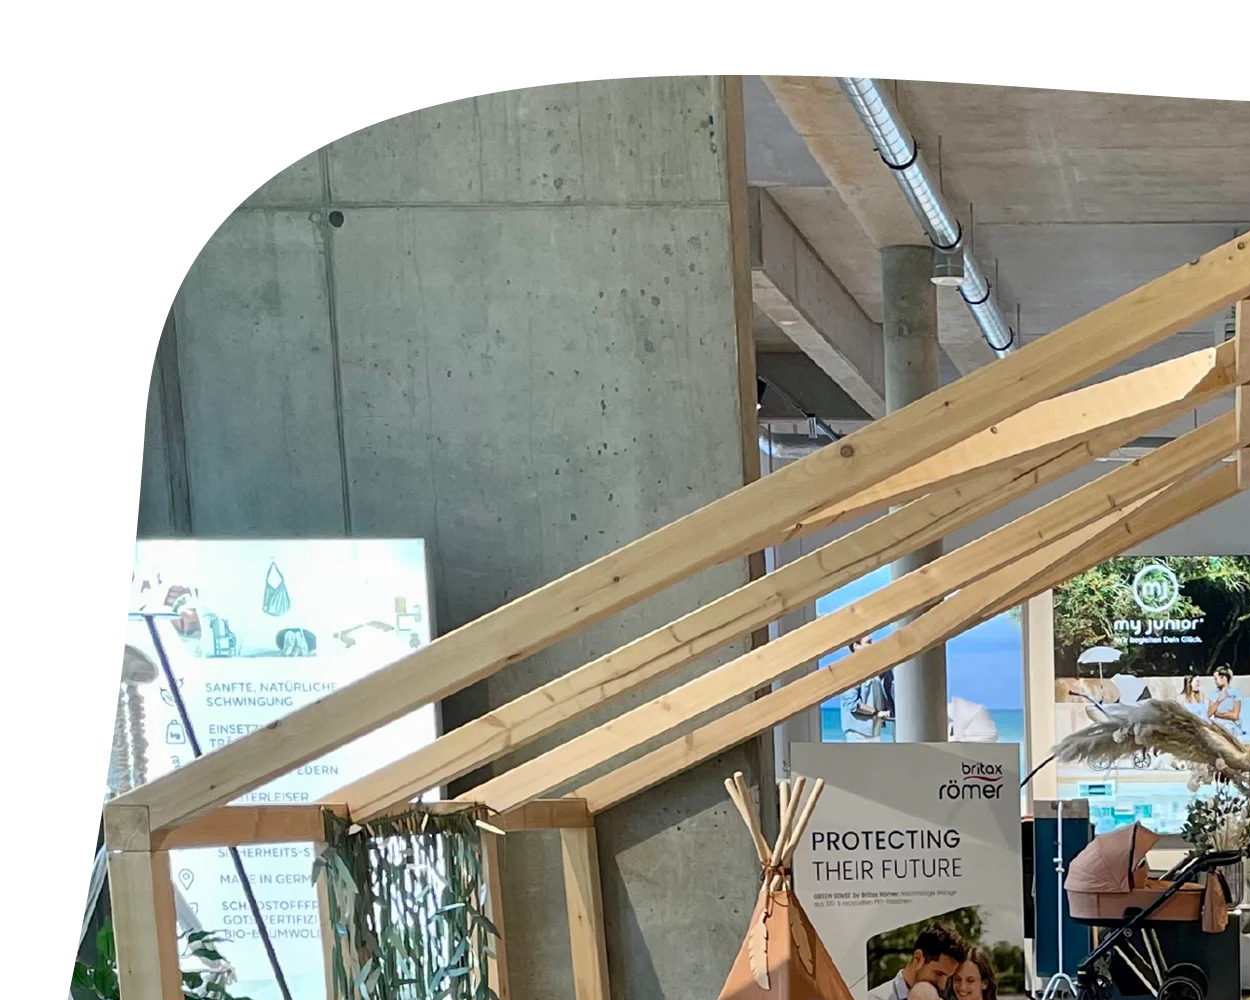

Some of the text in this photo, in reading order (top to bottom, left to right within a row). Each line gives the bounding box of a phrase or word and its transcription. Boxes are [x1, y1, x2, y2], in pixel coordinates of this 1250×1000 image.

[1113, 618, 1142, 636] my
[205, 682, 256, 694] SANFTE,
[206, 696, 293, 707] SCHWINGUNG
[961, 762, 1003, 775] britax
[938, 780, 1003, 800] römer
[811, 829, 961, 851] PROTECTING
[812, 858, 963, 881] THEIR FUTURE
[220, 874, 256, 884] MAE
[260, 874, 272, 884] IN
